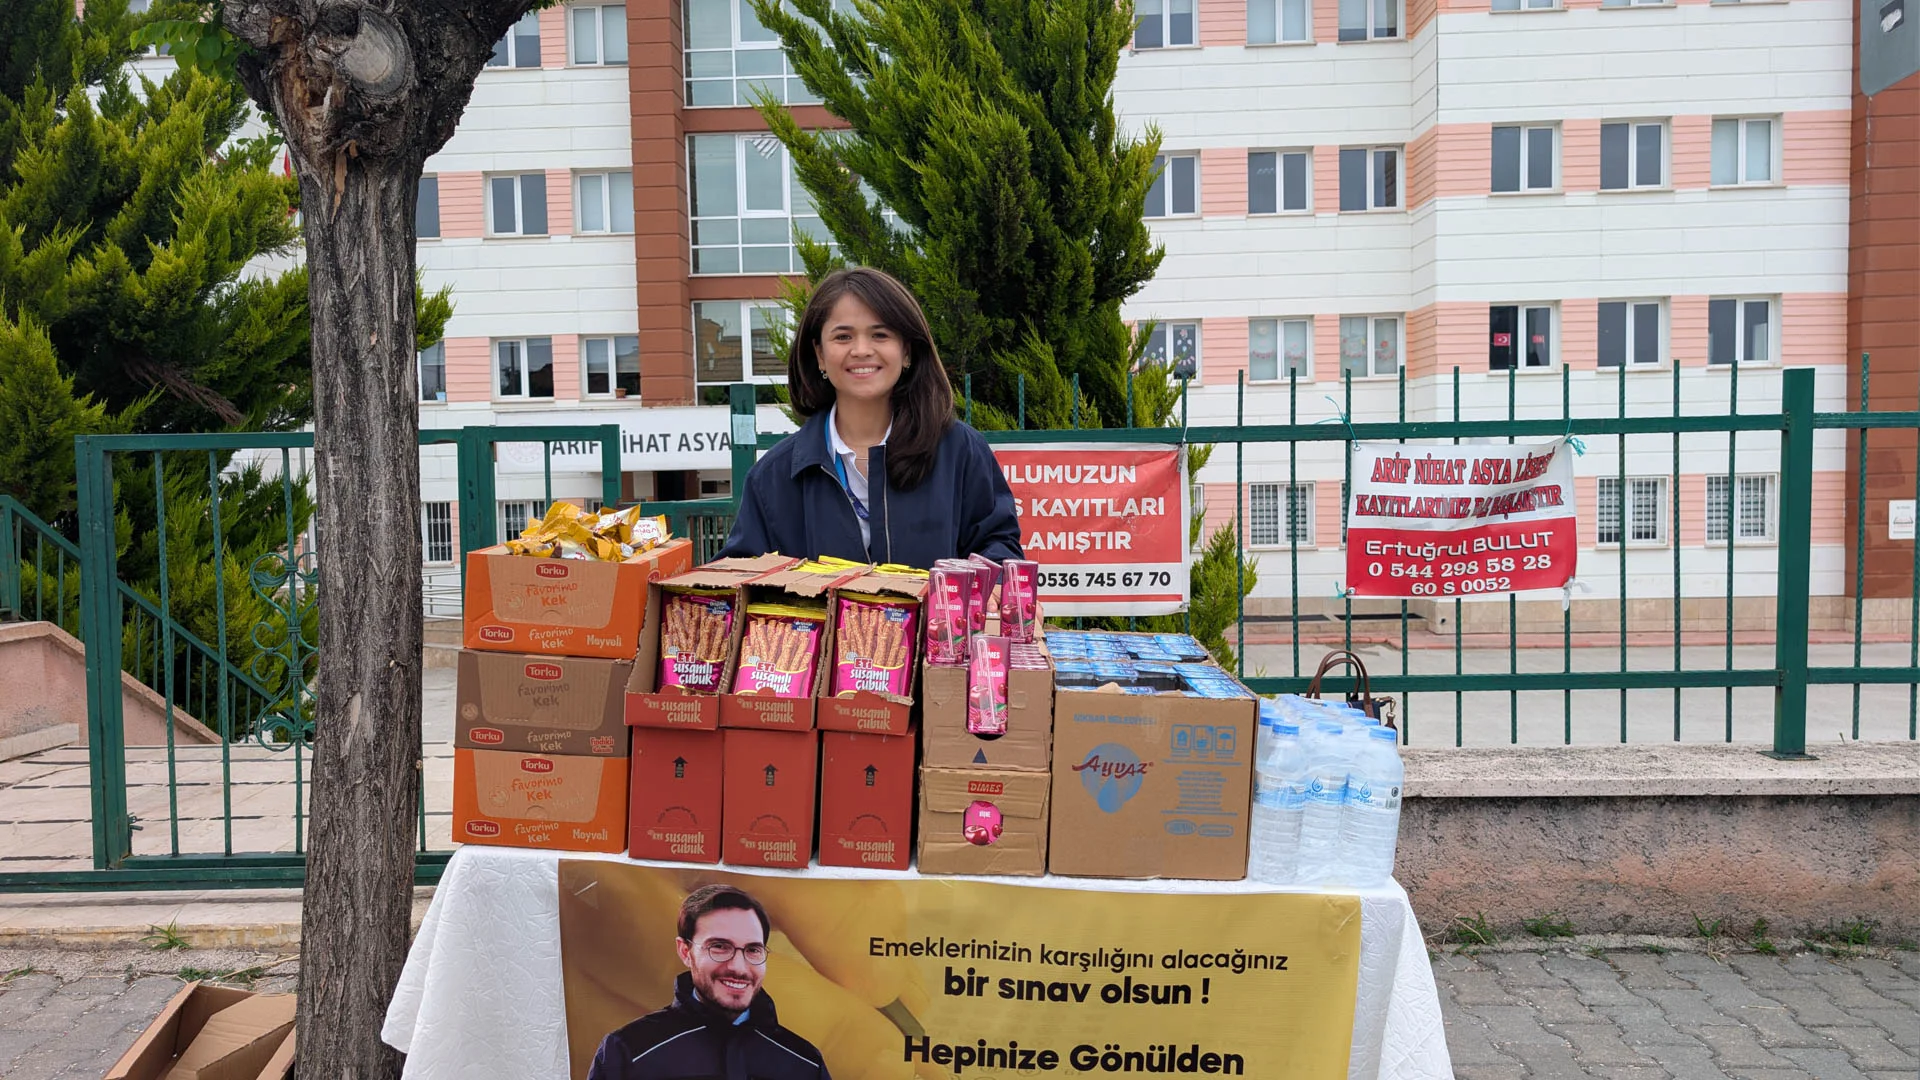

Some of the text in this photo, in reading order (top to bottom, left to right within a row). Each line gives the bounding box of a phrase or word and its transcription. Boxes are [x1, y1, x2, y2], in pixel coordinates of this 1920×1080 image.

[622, 430, 671, 453] İHAT
[677, 432, 731, 452] ASYA
[1370, 452, 1411, 483] ARİF
[1414, 453, 1467, 484] NİHAT
[1469, 458, 1512, 485] ASYA
[1031, 496, 1165, 517] KAYITLARI
[1366, 532, 1553, 561] Ertuğrul BULUT
[539, 565, 565, 576] Torku
[1368, 554, 1552, 578] 0 544 298 58 28
[1037, 571, 1171, 587] 0536 745 67 70
[1411, 577, 1511, 595] 60 S 0052
[541, 594, 567, 606] Kek
[484, 628, 510, 639] Torku
[542, 639, 564, 648] Kek
[528, 666, 558, 677] Torku
[673, 661, 713, 673] susamlı
[679, 674, 713, 685] çubuk
[751, 670, 792, 683] susamlı
[850, 668, 889, 681] susamlı
[855, 679, 889, 692] çubuk
[661, 700, 701, 712] susamlı
[754, 700, 793, 712] susamlı
[667, 711, 702, 723] çubuk
[760, 711, 794, 723] çubuk
[851, 707, 891, 719] susamlı
[857, 718, 891, 730] çubuk
[474, 731, 499, 740] Torku
[540, 742, 562, 751] Kek
[524, 760, 550, 770] Torku
[527, 790, 552, 801] Kek
[471, 823, 495, 832] Torku
[528, 833, 550, 843] Kek
[665, 832, 704, 844] susamlı
[670, 843, 705, 855] çubuk
[757, 839, 796, 851] susamlı
[855, 840, 895, 852] susamlı
[763, 850, 798, 862] çubuk
[861, 850, 896, 863] çubuk
[869, 937, 1289, 973] Emeklerinizin karşılığını alacağınız
[944, 966, 989, 997] bir
[997, 976, 1091, 1003] sınav
[1100, 975, 1192, 1004] olsun
[903, 1035, 1245, 1075] Hepinize Gönülden
